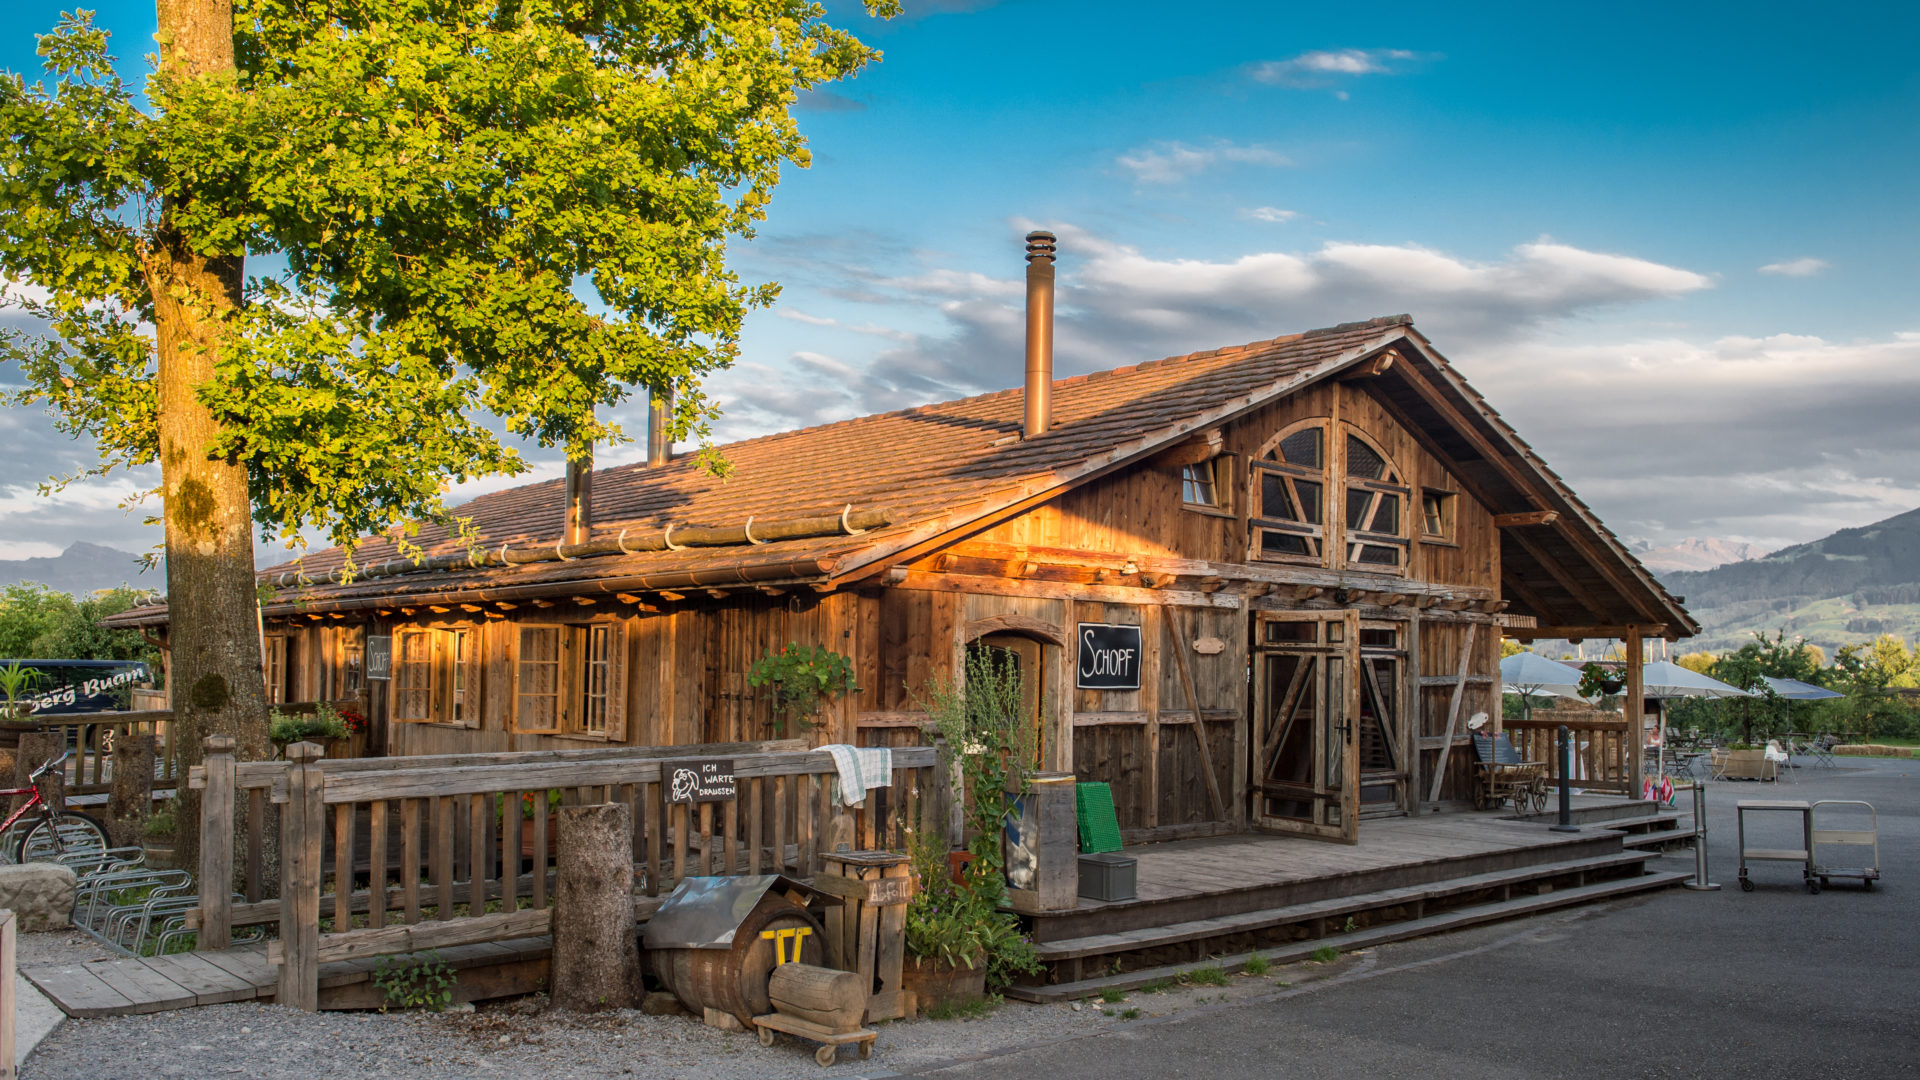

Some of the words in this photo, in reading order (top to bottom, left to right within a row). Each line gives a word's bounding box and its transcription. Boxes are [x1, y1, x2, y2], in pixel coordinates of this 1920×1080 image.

[1081, 629, 1135, 678] SCHOPF
[82, 667, 145, 699] Buam
[702, 764, 717, 773] ICH
[704, 775, 734, 784] WARTE
[699, 787, 735, 796] DRAUSSEN
